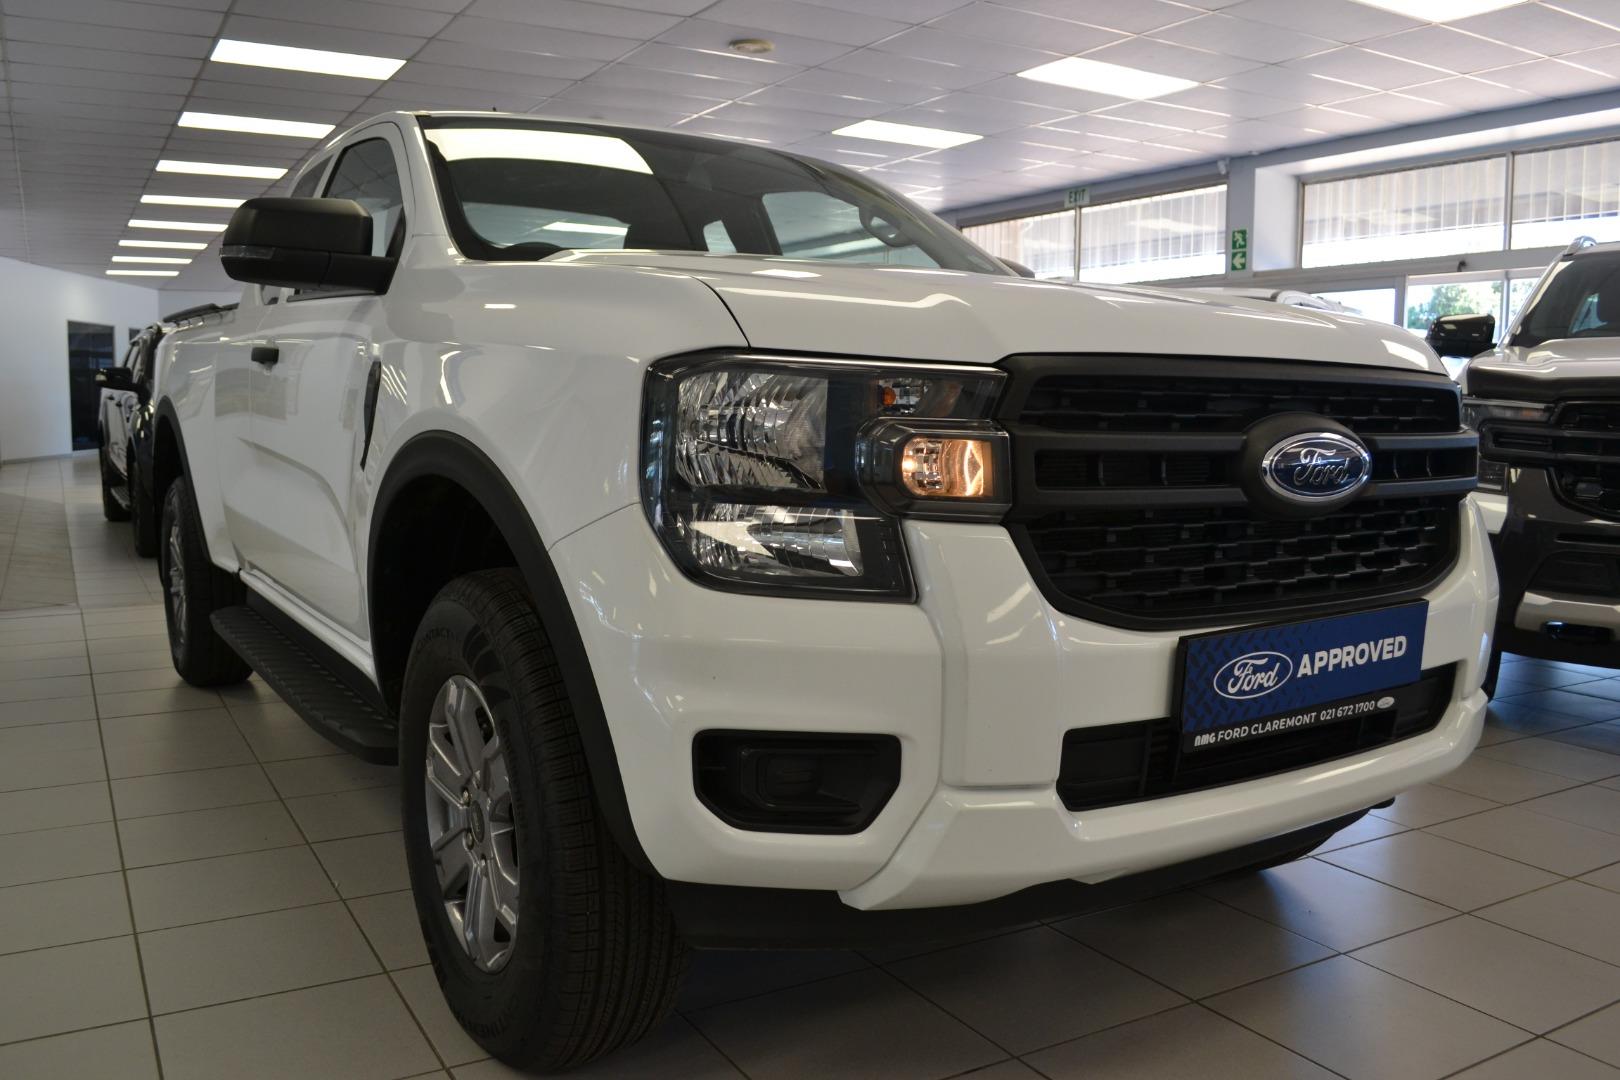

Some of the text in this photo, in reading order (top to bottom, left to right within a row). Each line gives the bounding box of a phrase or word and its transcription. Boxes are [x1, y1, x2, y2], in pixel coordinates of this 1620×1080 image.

[1069, 188, 1087, 204] EXIT
[1294, 447, 1349, 486] Ford
[1227, 635, 1407, 694] Ford APPROVED
[1217, 726, 1249, 742] FORD
[1251, 712, 1317, 735] CLAREMONT
[1320, 708, 1335, 721] 021
[1336, 704, 1353, 718] 672
[1355, 700, 1375, 714] 1700
